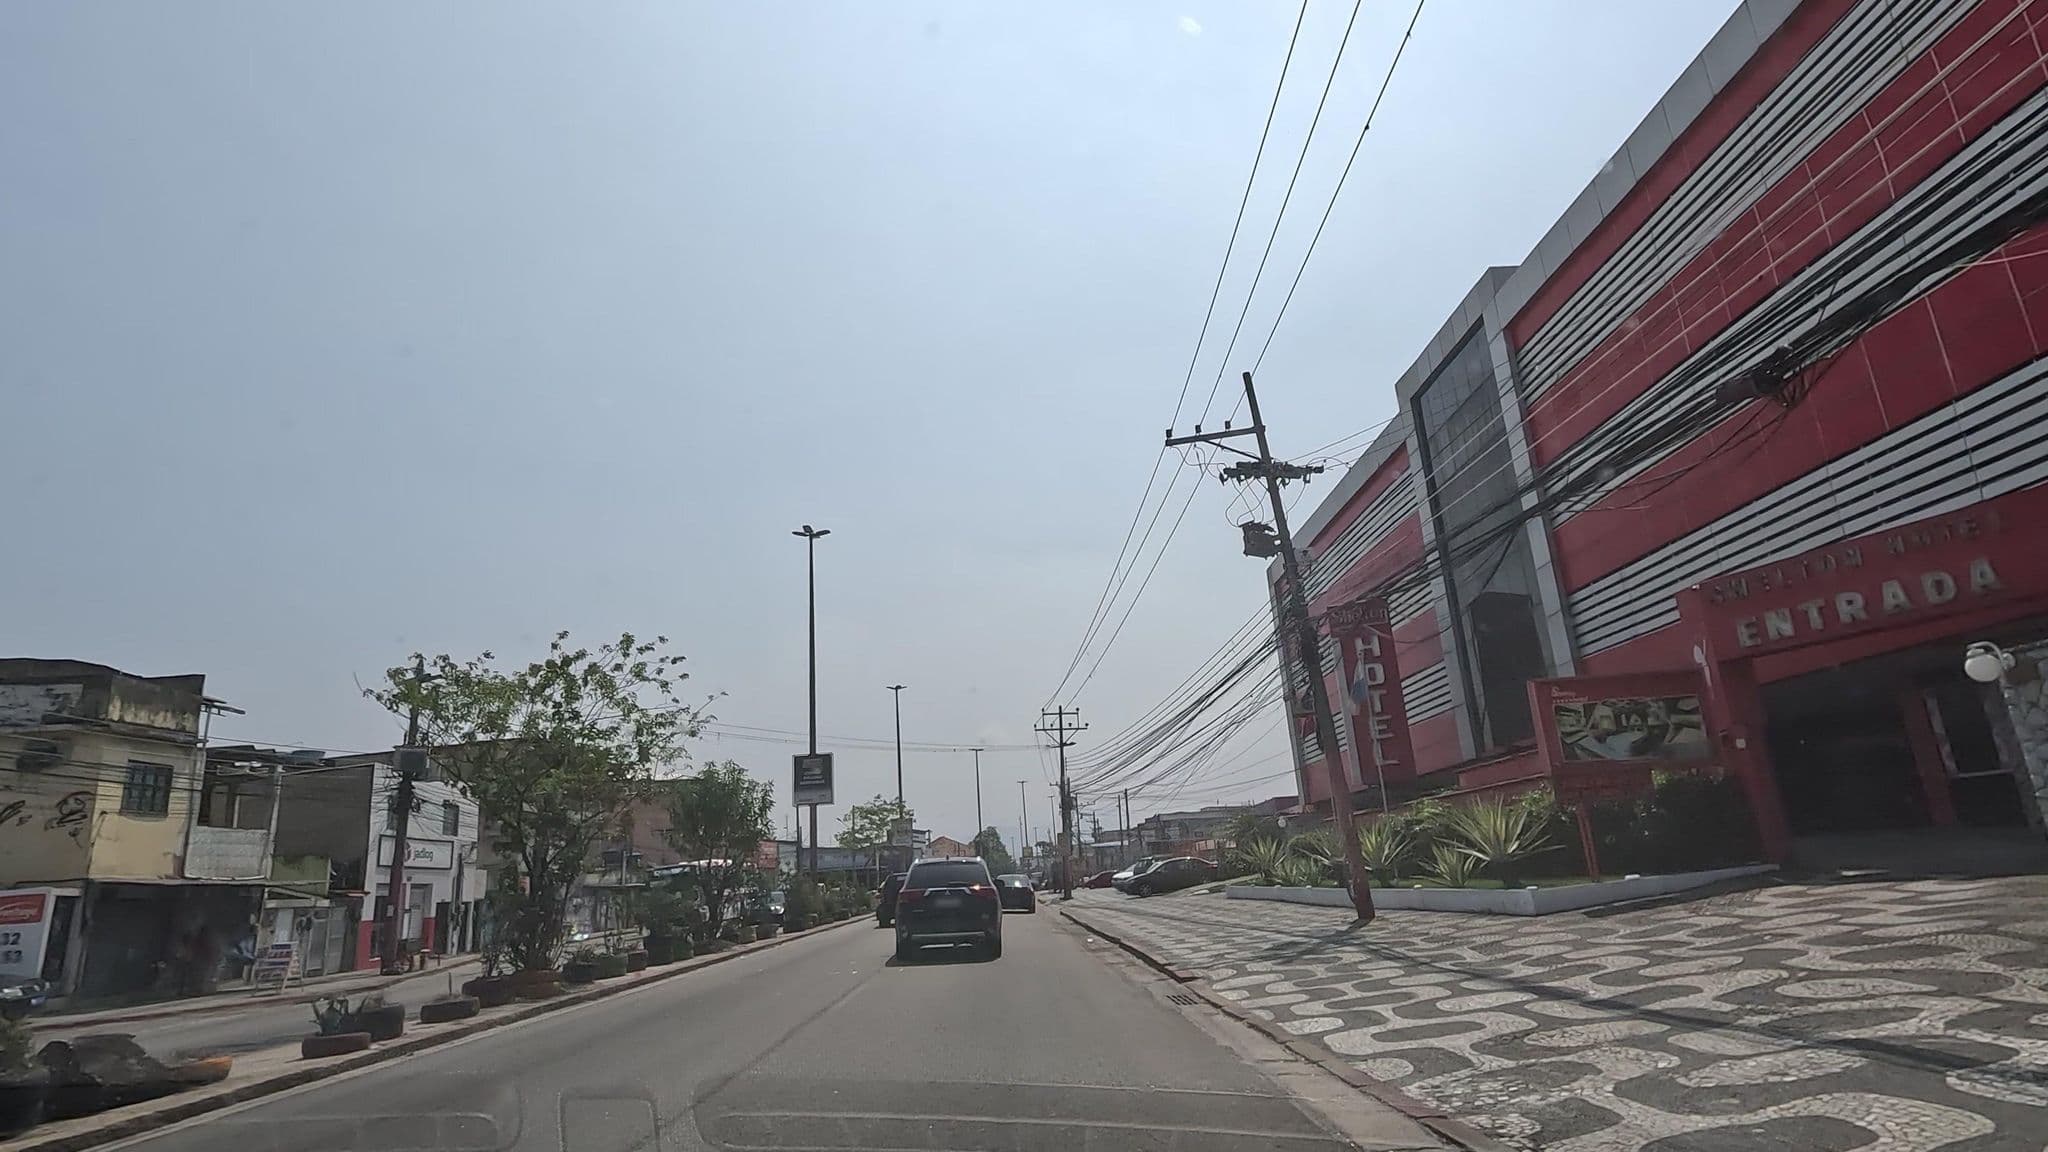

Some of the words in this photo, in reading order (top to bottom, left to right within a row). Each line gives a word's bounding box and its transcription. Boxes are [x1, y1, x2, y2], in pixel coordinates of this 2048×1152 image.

[1736, 556, 2002, 648] ENTRADA
[1354, 634, 1401, 766] HOTEL
[412, 847, 434, 862] jadlog
